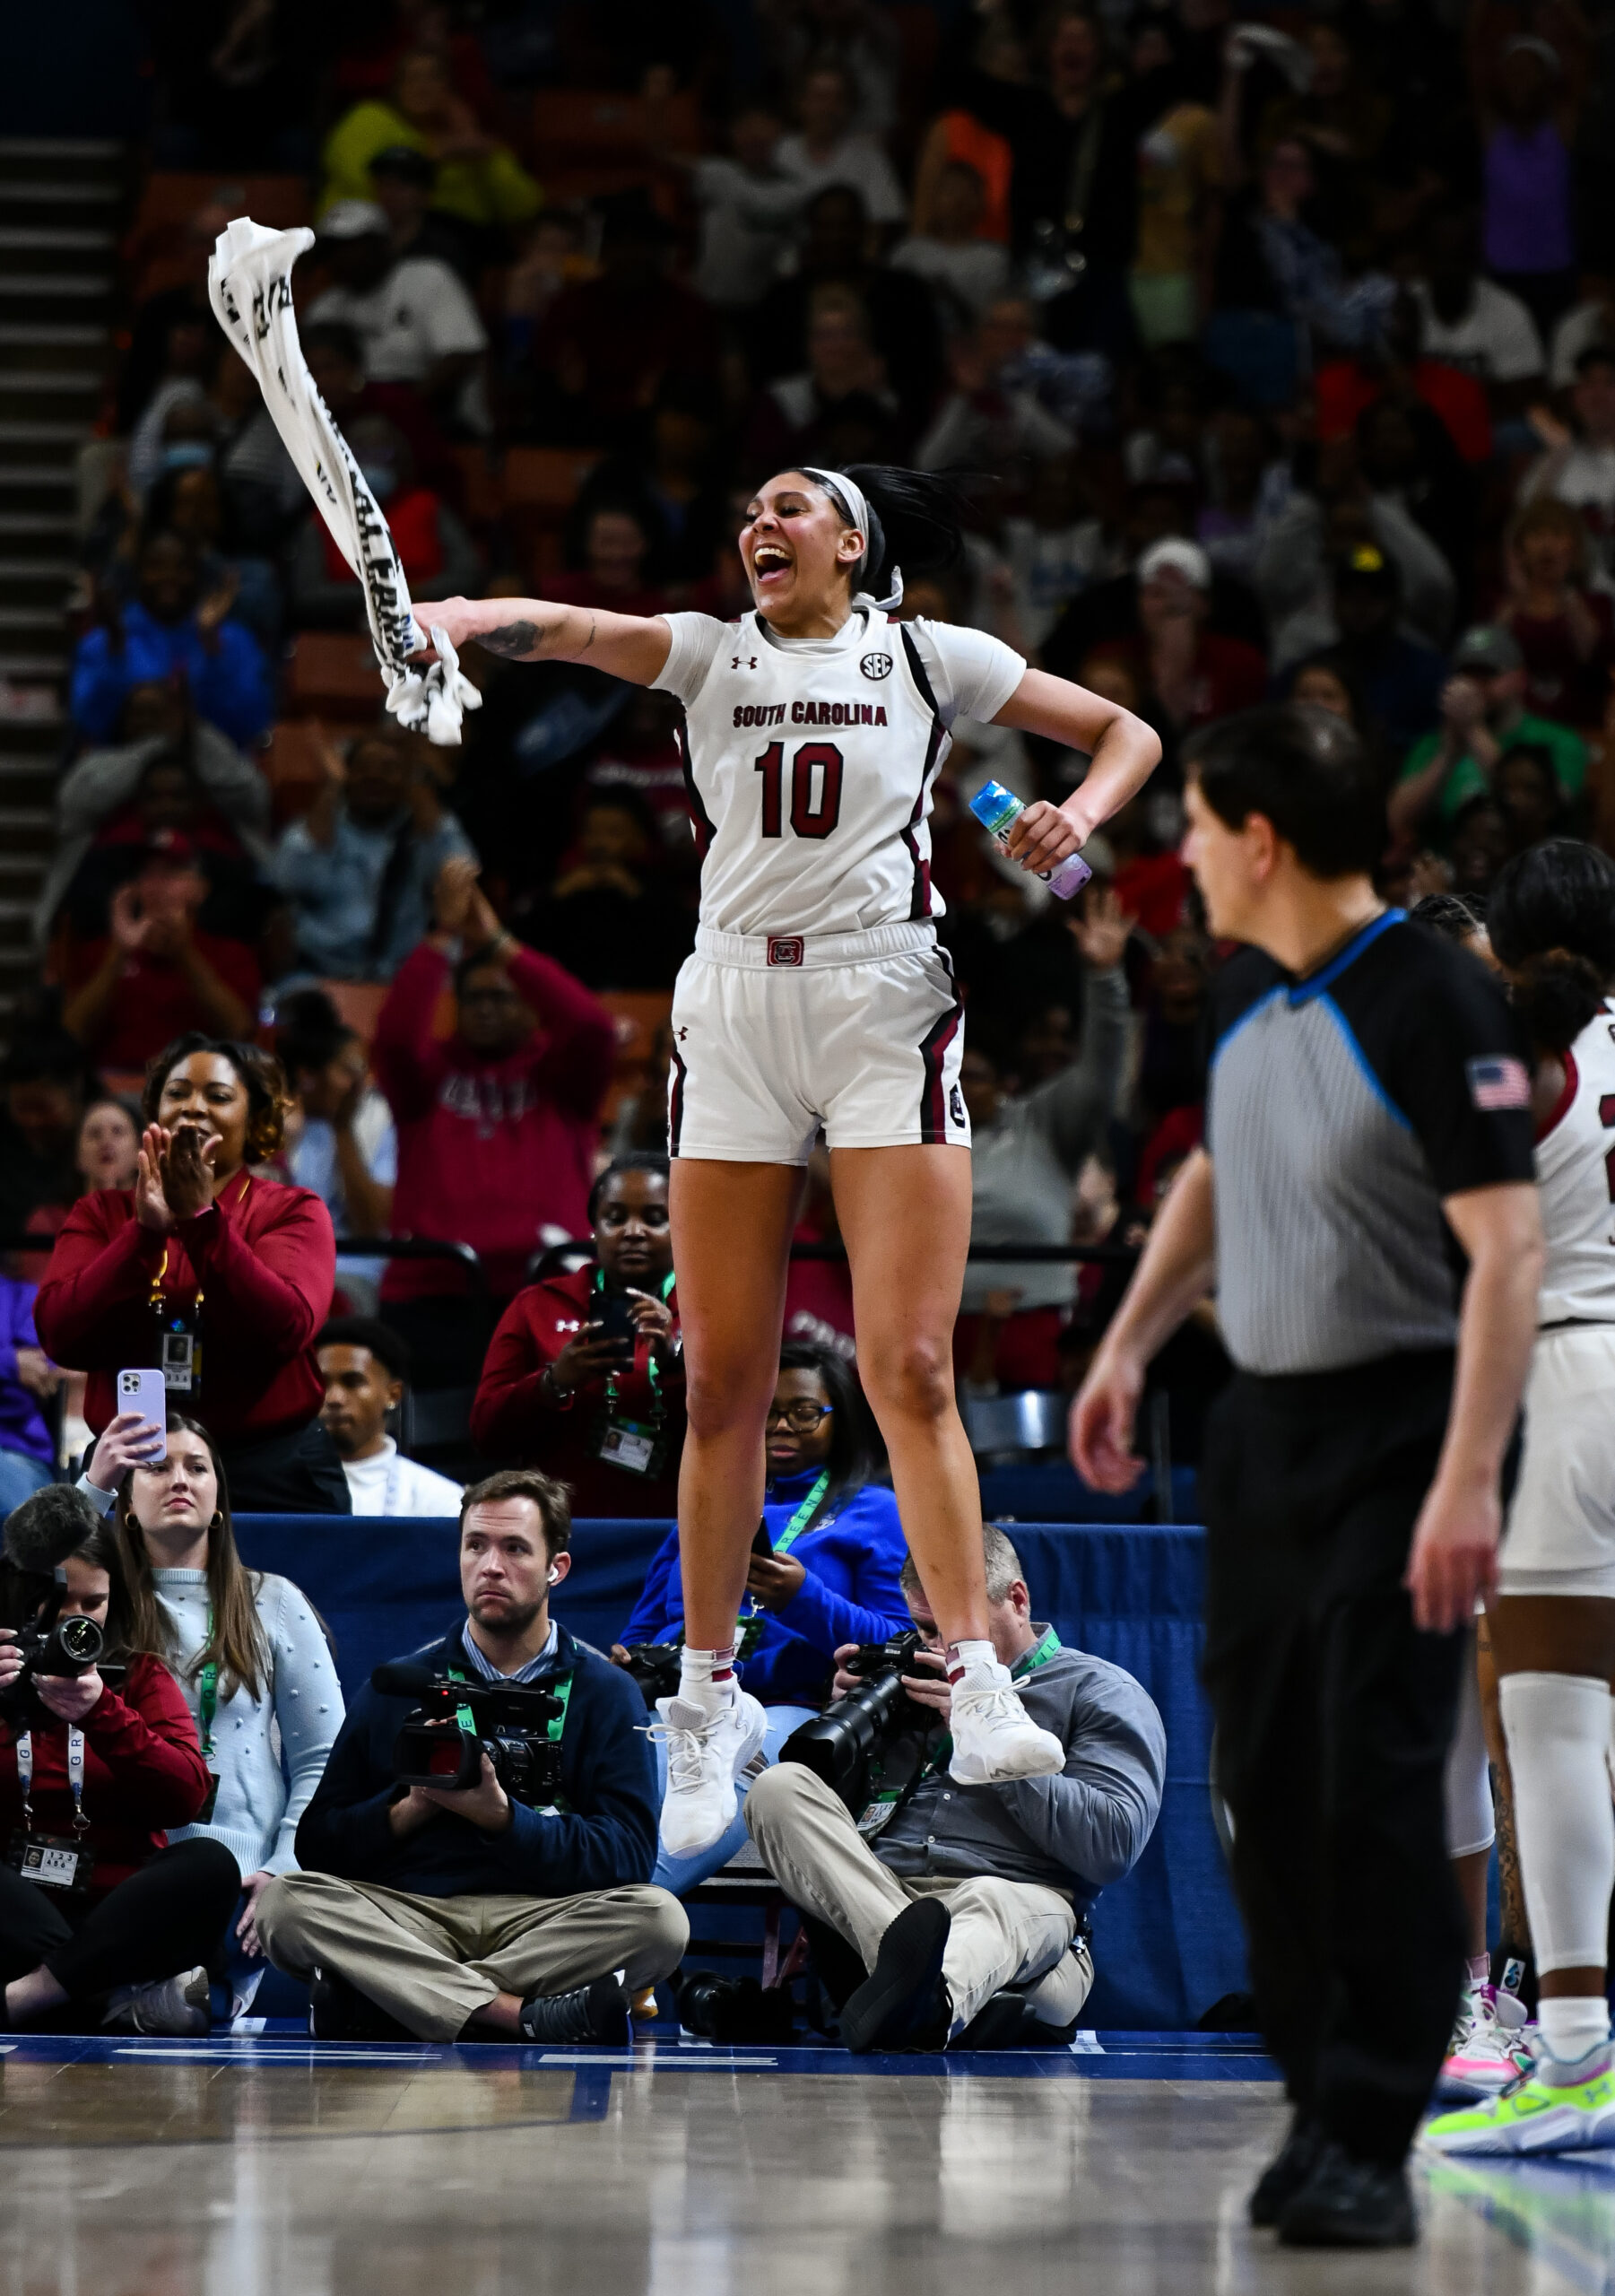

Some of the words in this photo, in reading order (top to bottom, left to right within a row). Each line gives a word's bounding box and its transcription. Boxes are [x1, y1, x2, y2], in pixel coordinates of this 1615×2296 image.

[863, 654, 891, 679] SEC
[733, 703, 786, 728] SOUTH
[791, 701, 888, 726] CAROLINA
[754, 741, 844, 839] 10
[774, 1484, 824, 1552] REENV
